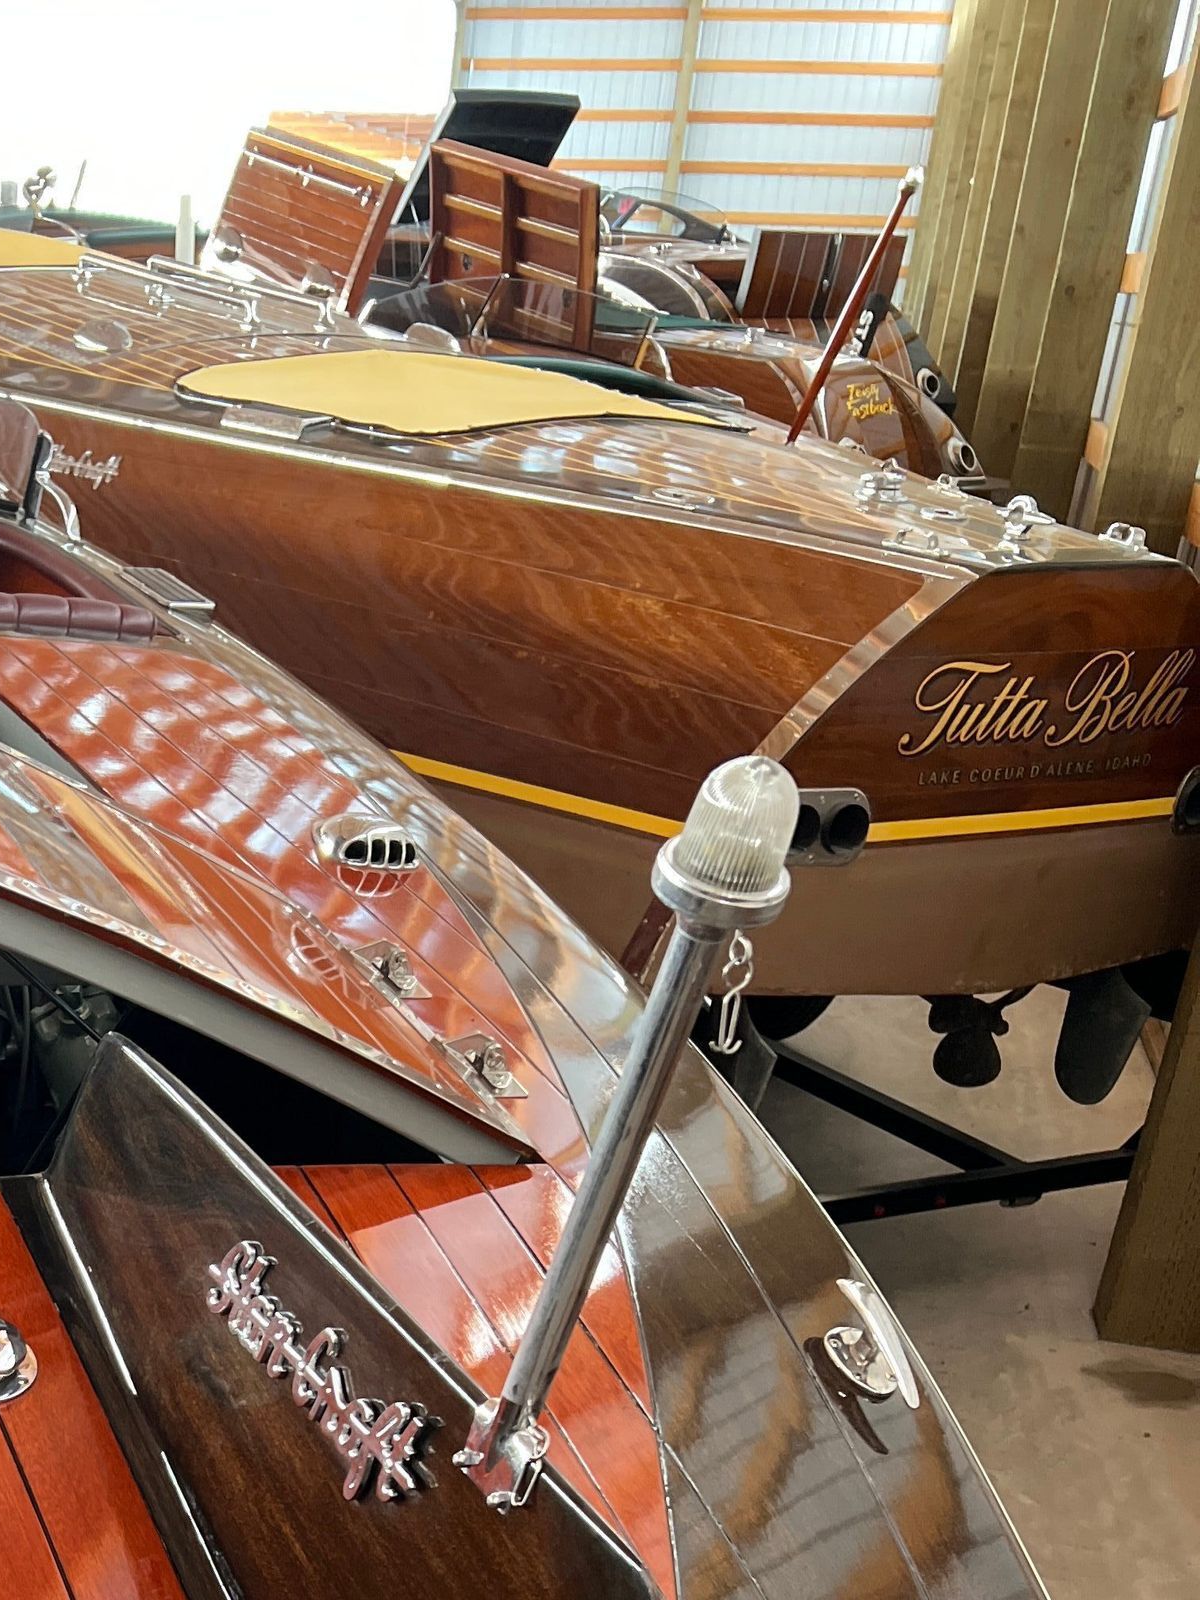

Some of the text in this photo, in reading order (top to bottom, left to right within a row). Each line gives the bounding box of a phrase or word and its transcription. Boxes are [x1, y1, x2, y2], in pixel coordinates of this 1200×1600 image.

[846, 397, 899, 419] Fastback
[898, 648, 1196, 756] Tutta Bella
[918, 769, 961, 786] LAKE
[968, 765, 1026, 784] COEUR
[1105, 752, 1152, 771] IDAHO
